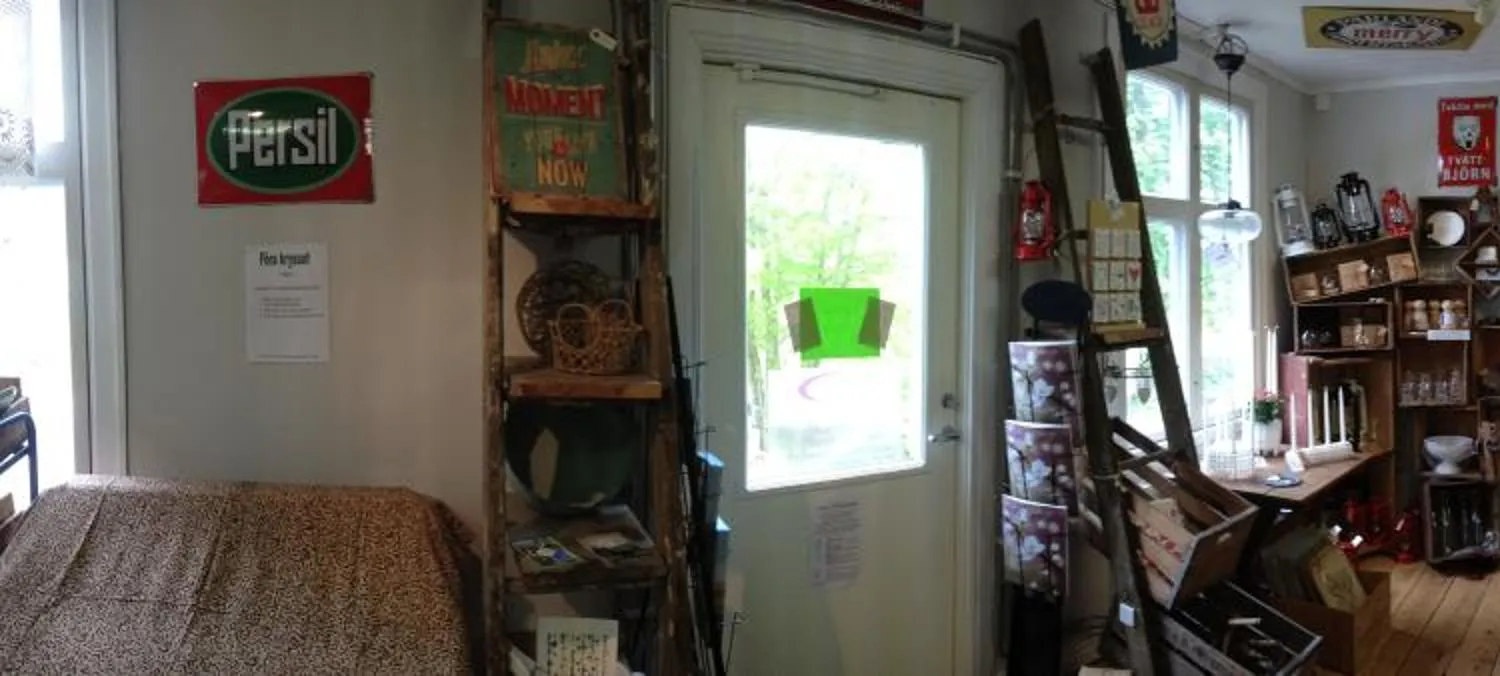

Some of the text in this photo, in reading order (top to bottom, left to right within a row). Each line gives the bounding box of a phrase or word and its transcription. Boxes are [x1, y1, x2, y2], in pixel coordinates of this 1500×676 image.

[505, 76, 607, 123] MOMENT
[226, 107, 337, 170] Persil
[537, 157, 589, 188] NOW
